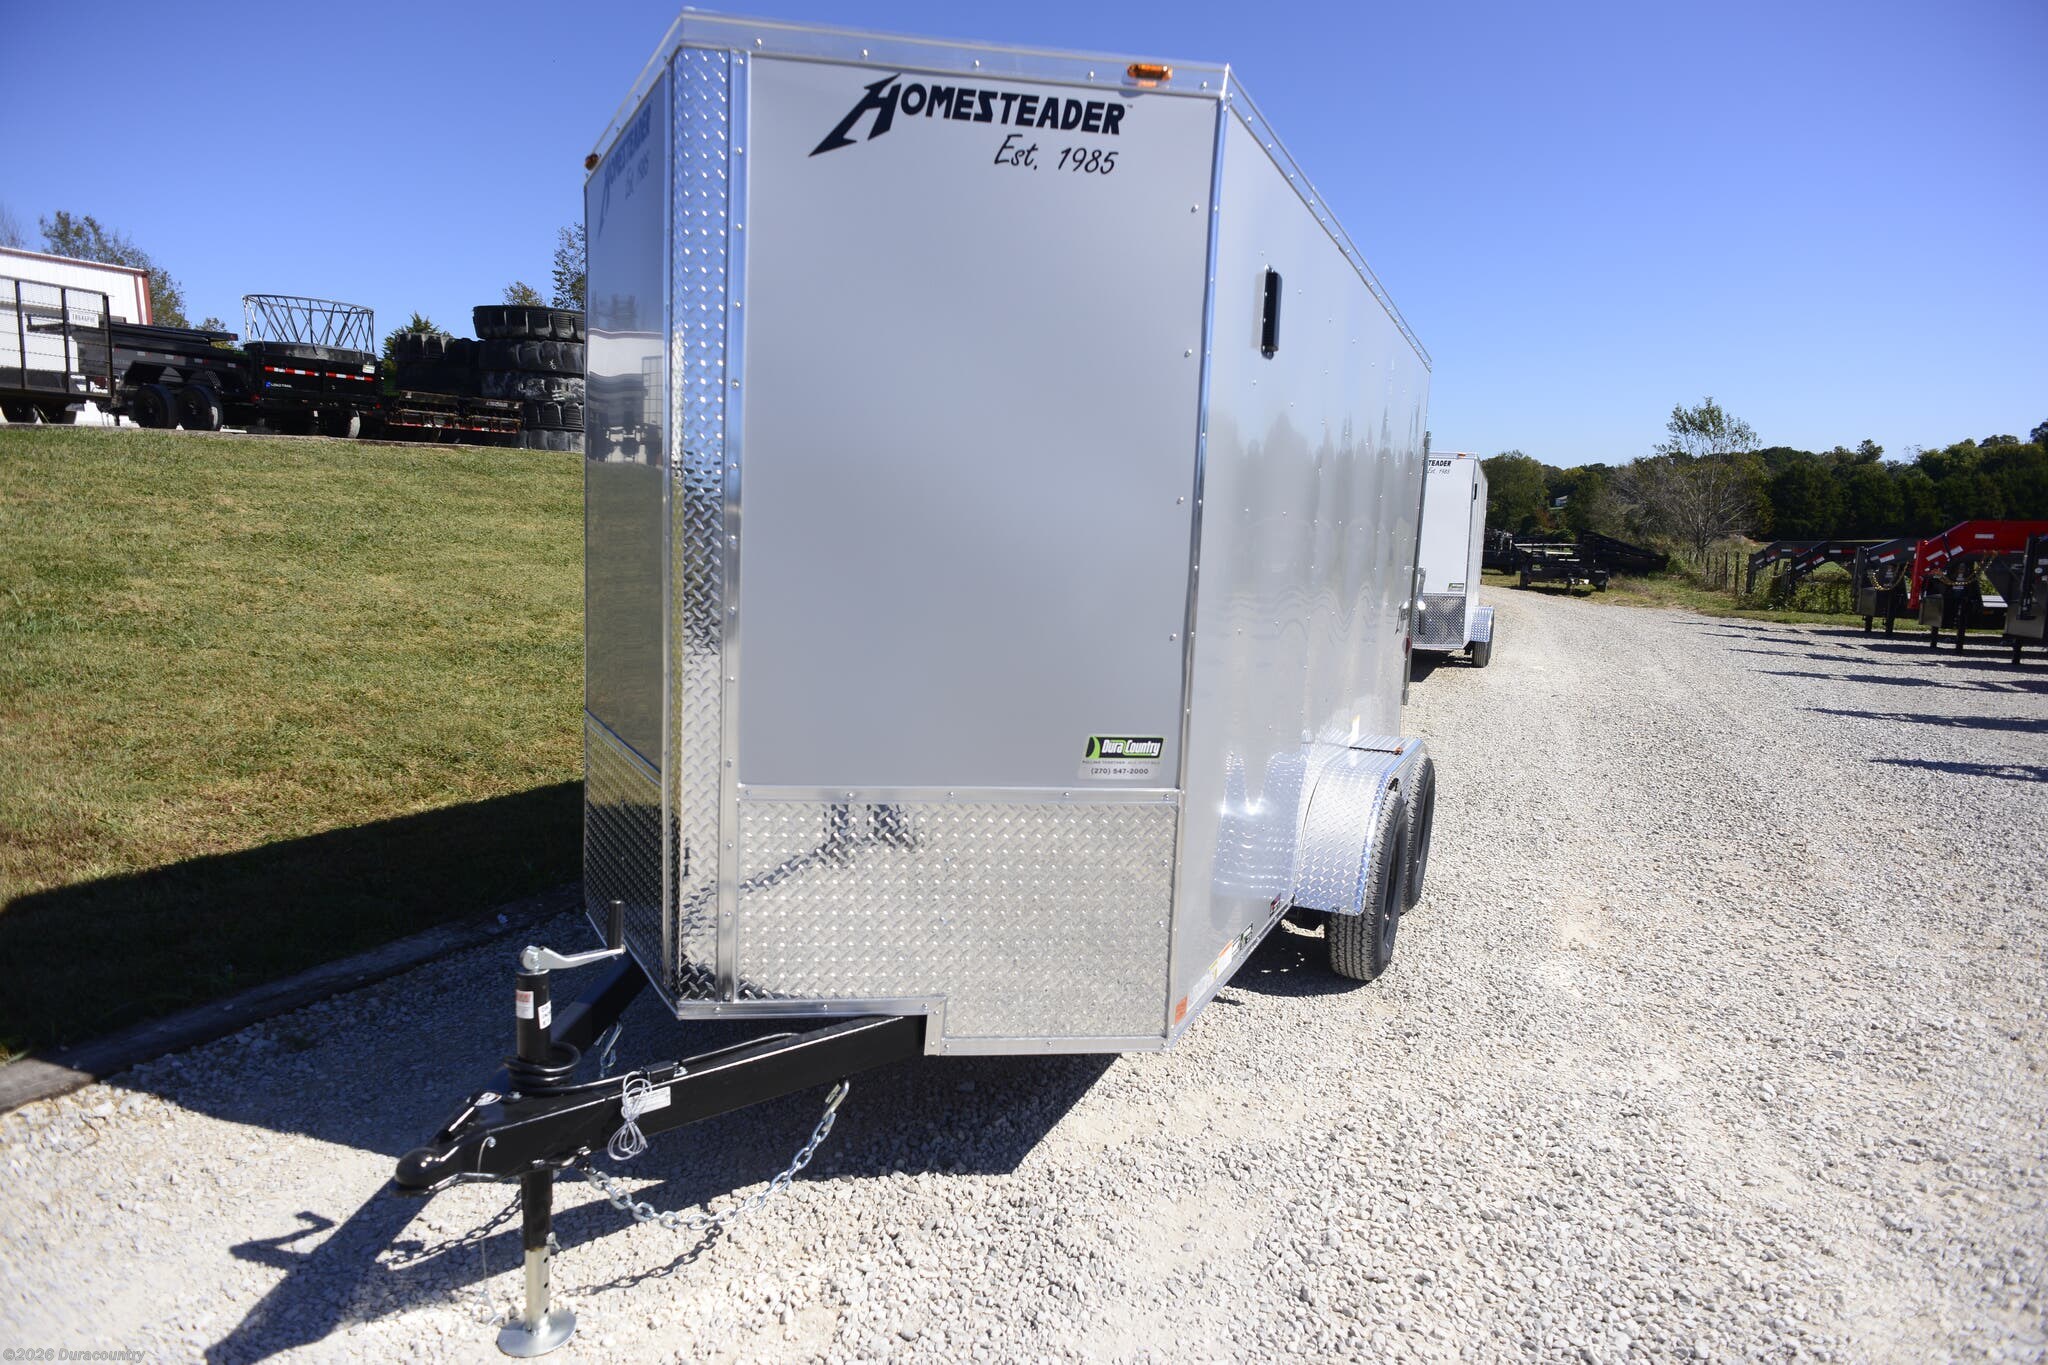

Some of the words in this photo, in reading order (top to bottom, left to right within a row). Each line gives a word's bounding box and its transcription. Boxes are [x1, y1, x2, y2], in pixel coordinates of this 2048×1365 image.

[808, 73, 1126, 157] HOMESTEADER
[994, 133, 1039, 171] Est.
[1058, 147, 1120, 175] 1985
[1101, 739, 1124, 753] Dura
[1125, 740, 1161, 756] Country
